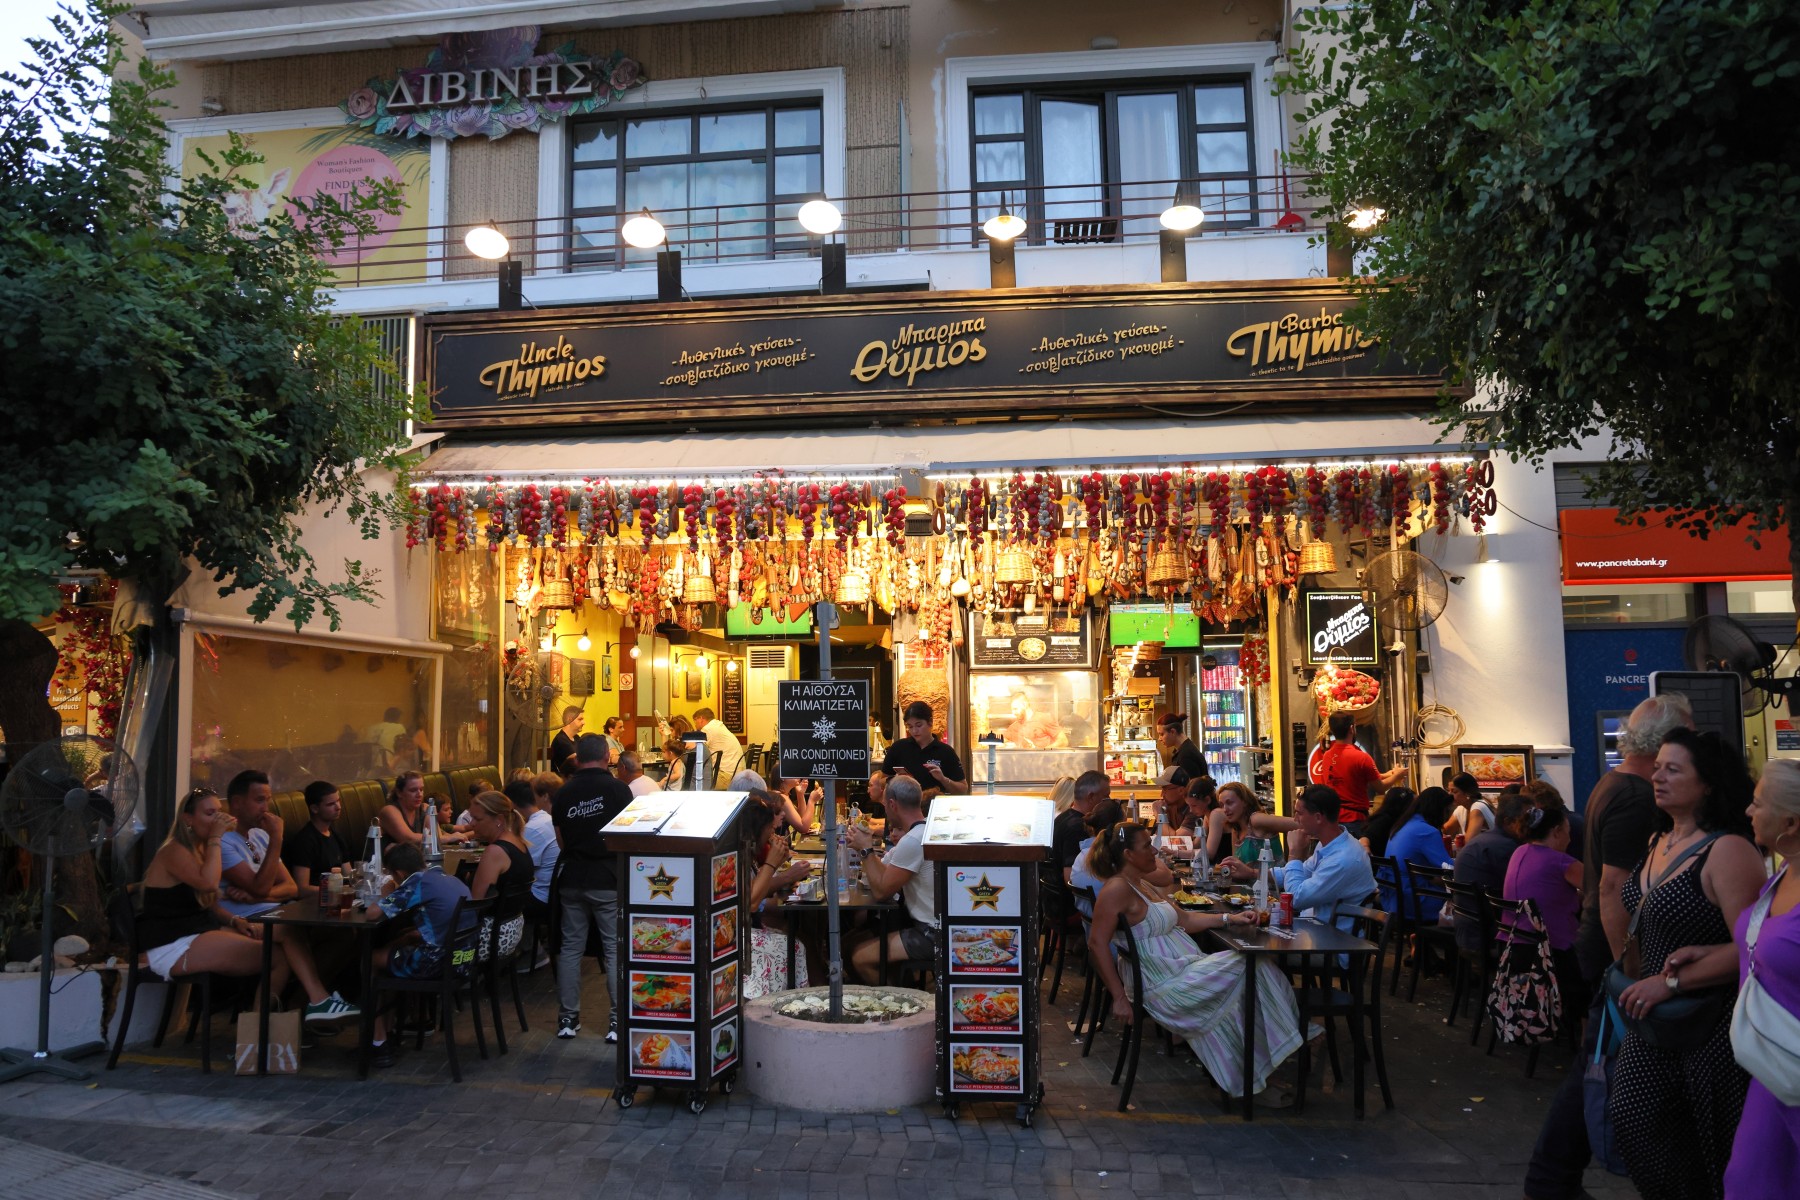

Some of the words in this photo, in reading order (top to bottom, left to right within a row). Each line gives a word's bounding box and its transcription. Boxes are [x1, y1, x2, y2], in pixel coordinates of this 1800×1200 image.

[386, 62, 592, 108] ΔΙΒΙΝΗΣ
[317, 159, 347, 167] Woman's
[349, 157, 375, 165] Fashion
[328, 166, 362, 175] Boutiques
[325, 180, 350, 190] FIND
[892, 317, 986, 350] Μπαρμπα
[520, 335, 575, 365] Uncle
[850, 338, 987, 387] Θύμιος
[480, 355, 606, 398] Thymios
[1576, 557, 1668, 569] www.pancretabank.gr
[1314, 612, 1370, 653] Θύμιος
[792, 685, 800, 696] Η
[803, 685, 856, 696] ΑΙΘΟΥΣΑ
[784, 699, 863, 711] ΚΛΙΜΑΤΙΖΕΤΑΙ
[783, 748, 799, 760] AIR
[801, 749, 866, 760] CONDITIONED
[811, 763, 838, 775] AREA
[235, 1043, 298, 1075] ZRA
